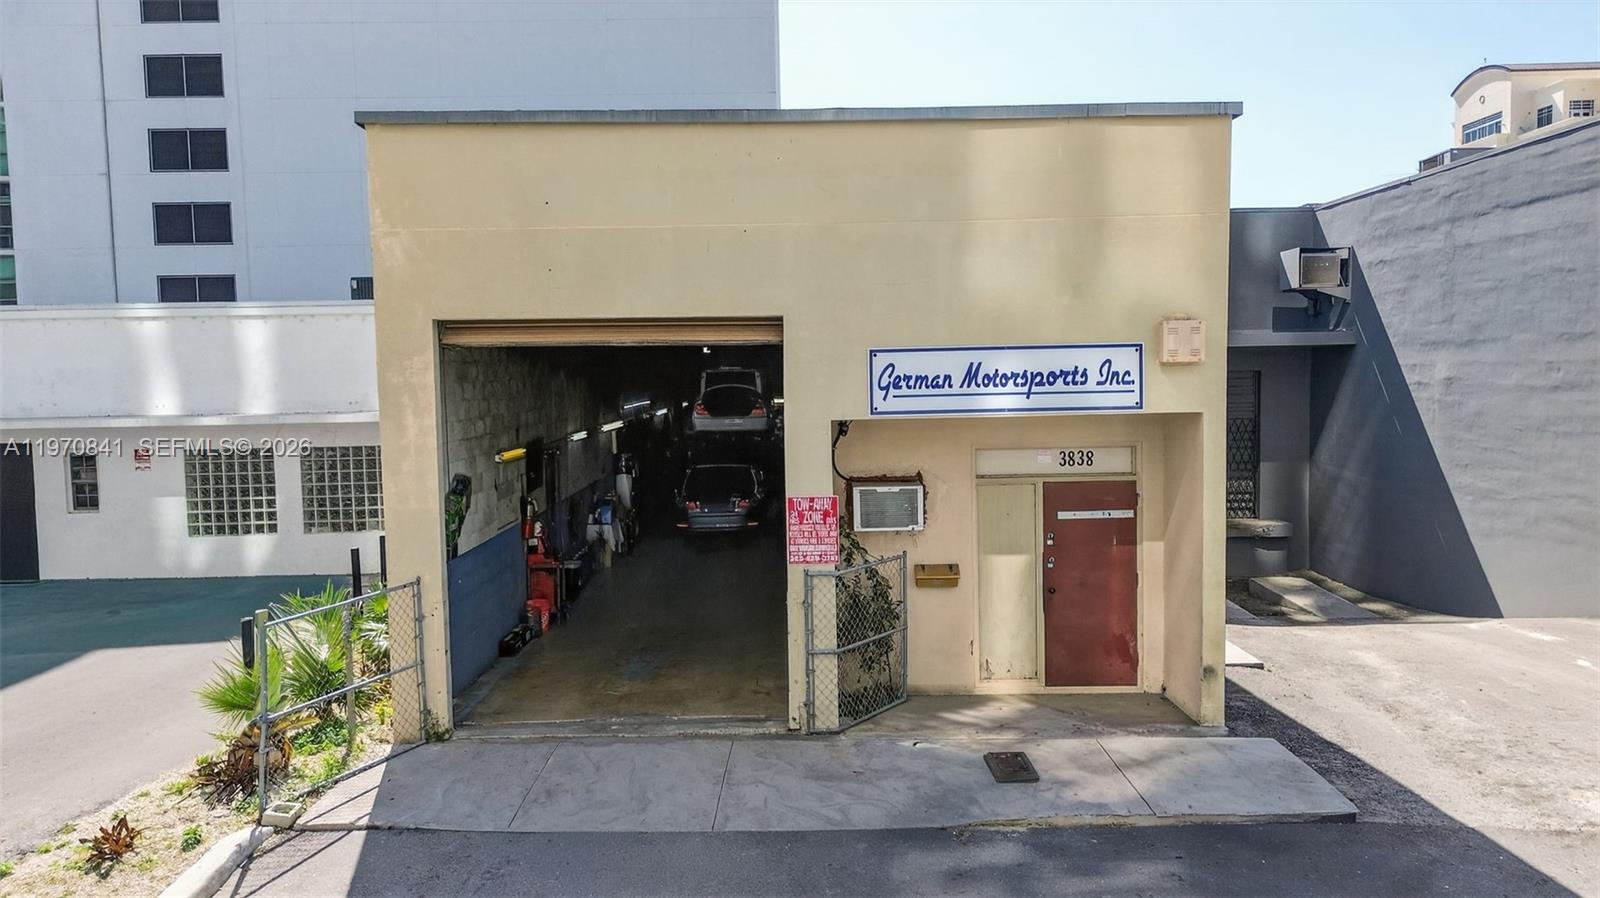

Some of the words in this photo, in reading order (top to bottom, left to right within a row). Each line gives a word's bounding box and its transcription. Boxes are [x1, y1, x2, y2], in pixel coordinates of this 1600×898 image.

[877, 362, 954, 402] German
[959, 361, 1089, 400] Motorsports
[1095, 358, 1135, 387] Inc.
[1059, 450, 1094, 467] 3838
[792, 497, 833, 511] TOW-AWAY
[802, 511, 824, 524] ZONE
